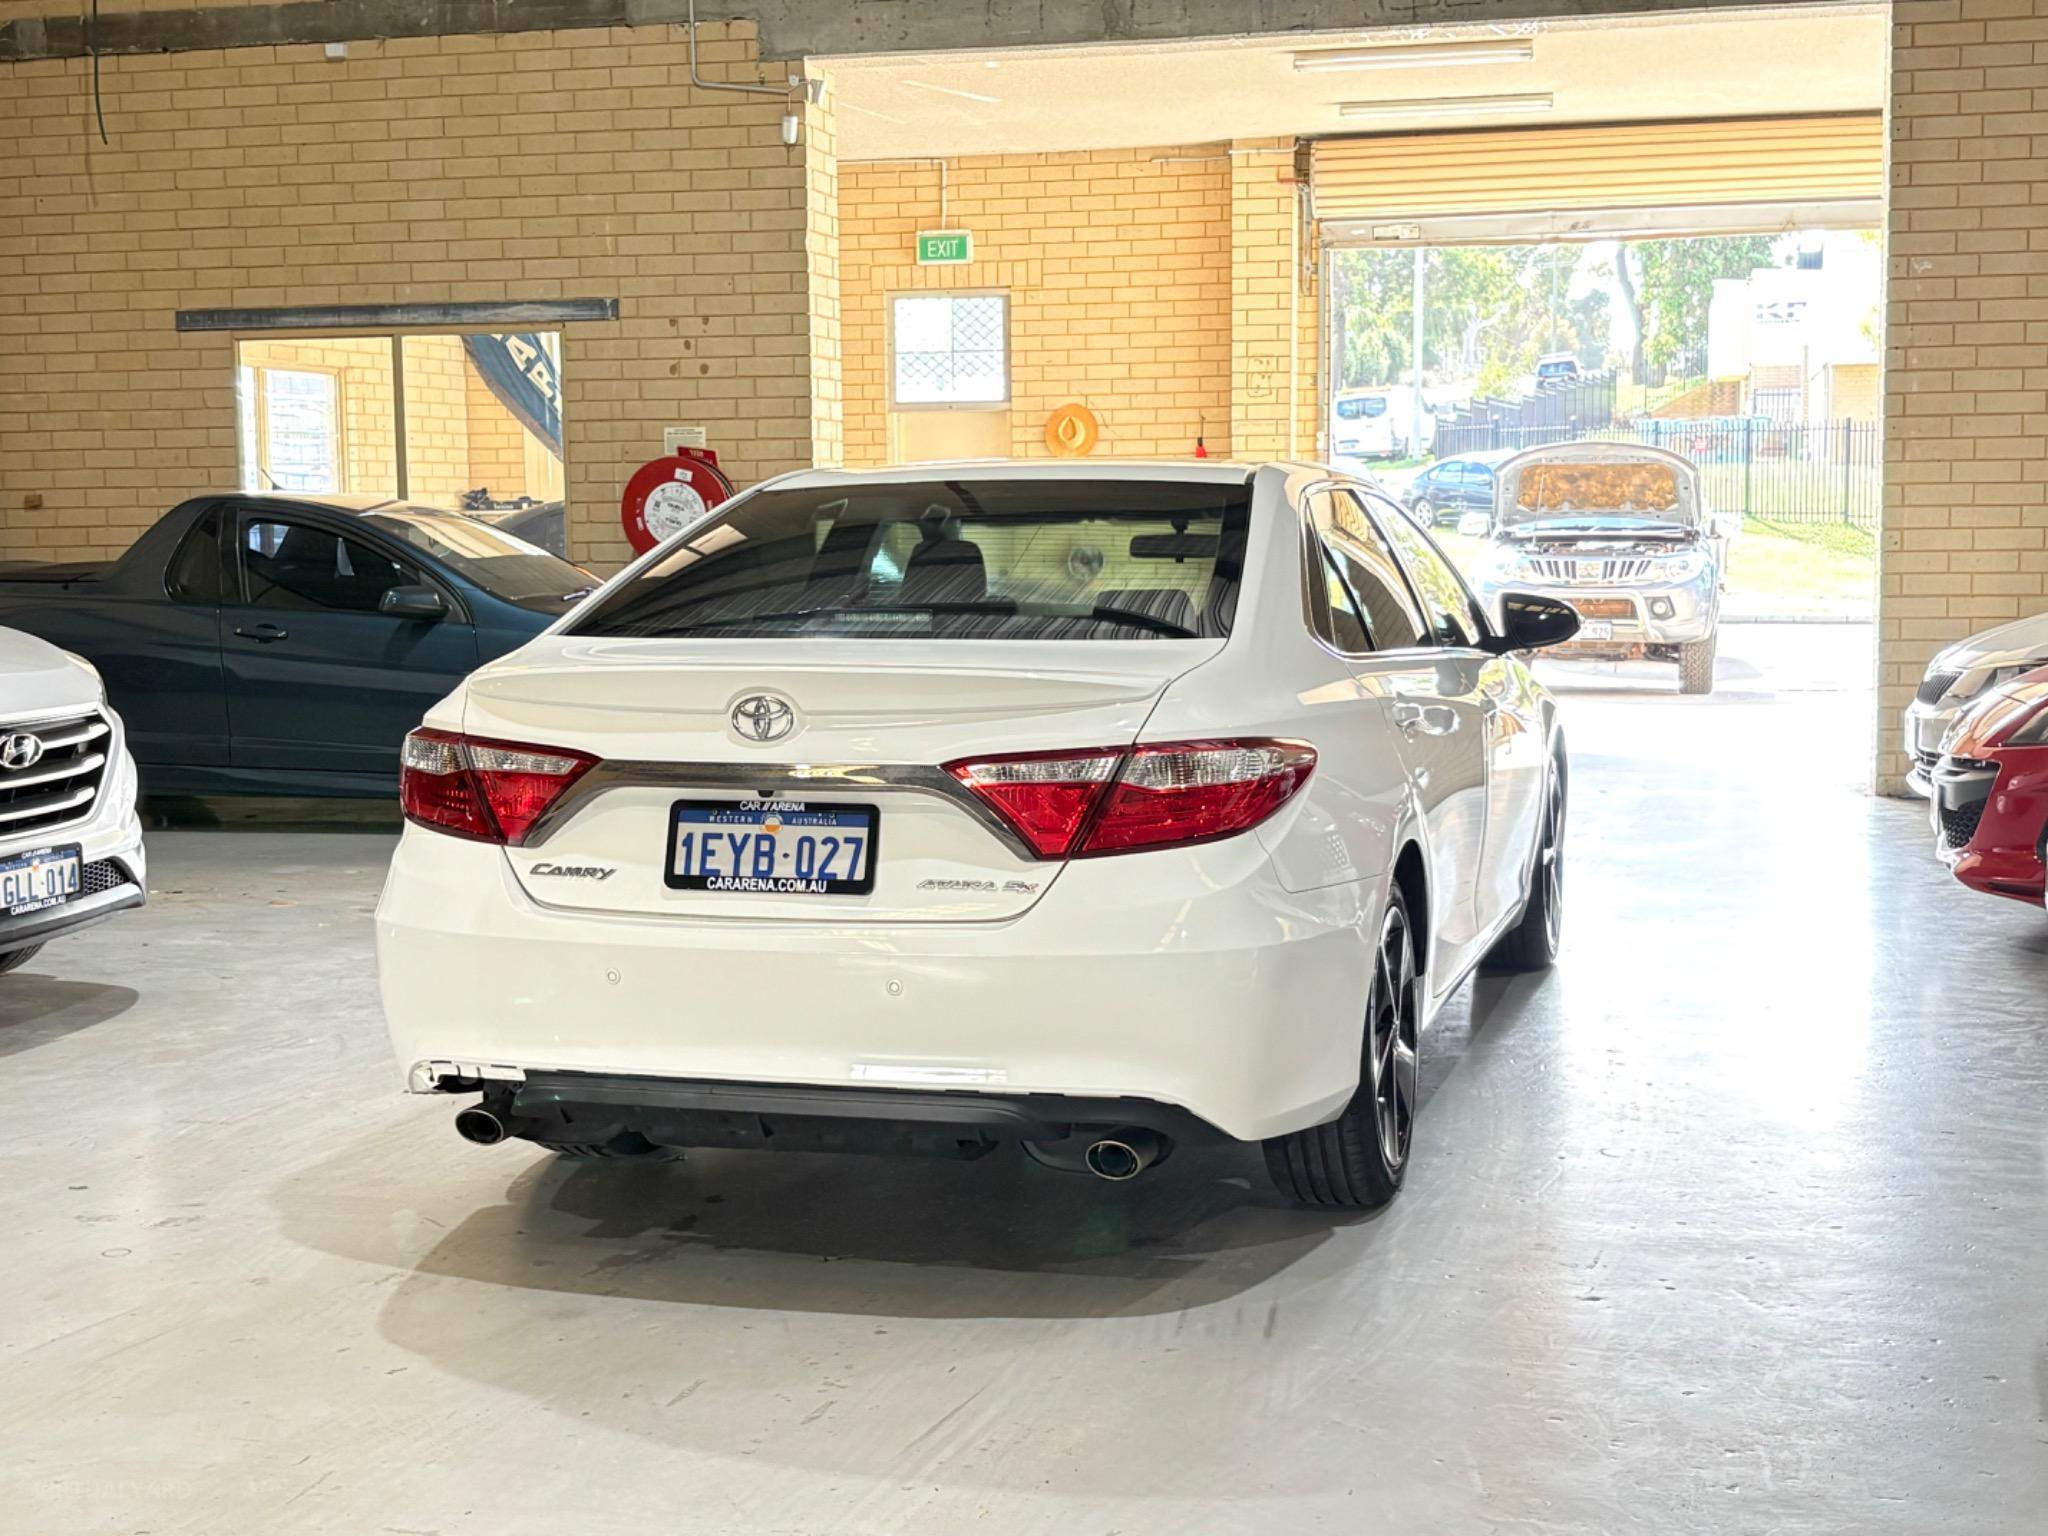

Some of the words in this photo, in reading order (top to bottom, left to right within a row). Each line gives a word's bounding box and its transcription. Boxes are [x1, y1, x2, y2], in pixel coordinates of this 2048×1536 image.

[927, 240, 959, 258] EXIT
[709, 815, 753, 824] WESTERN
[791, 816, 837, 826] AUSTRALIA
[529, 863, 618, 881] CAMRY
[706, 877, 828, 893] CARARENA.COM.AU
